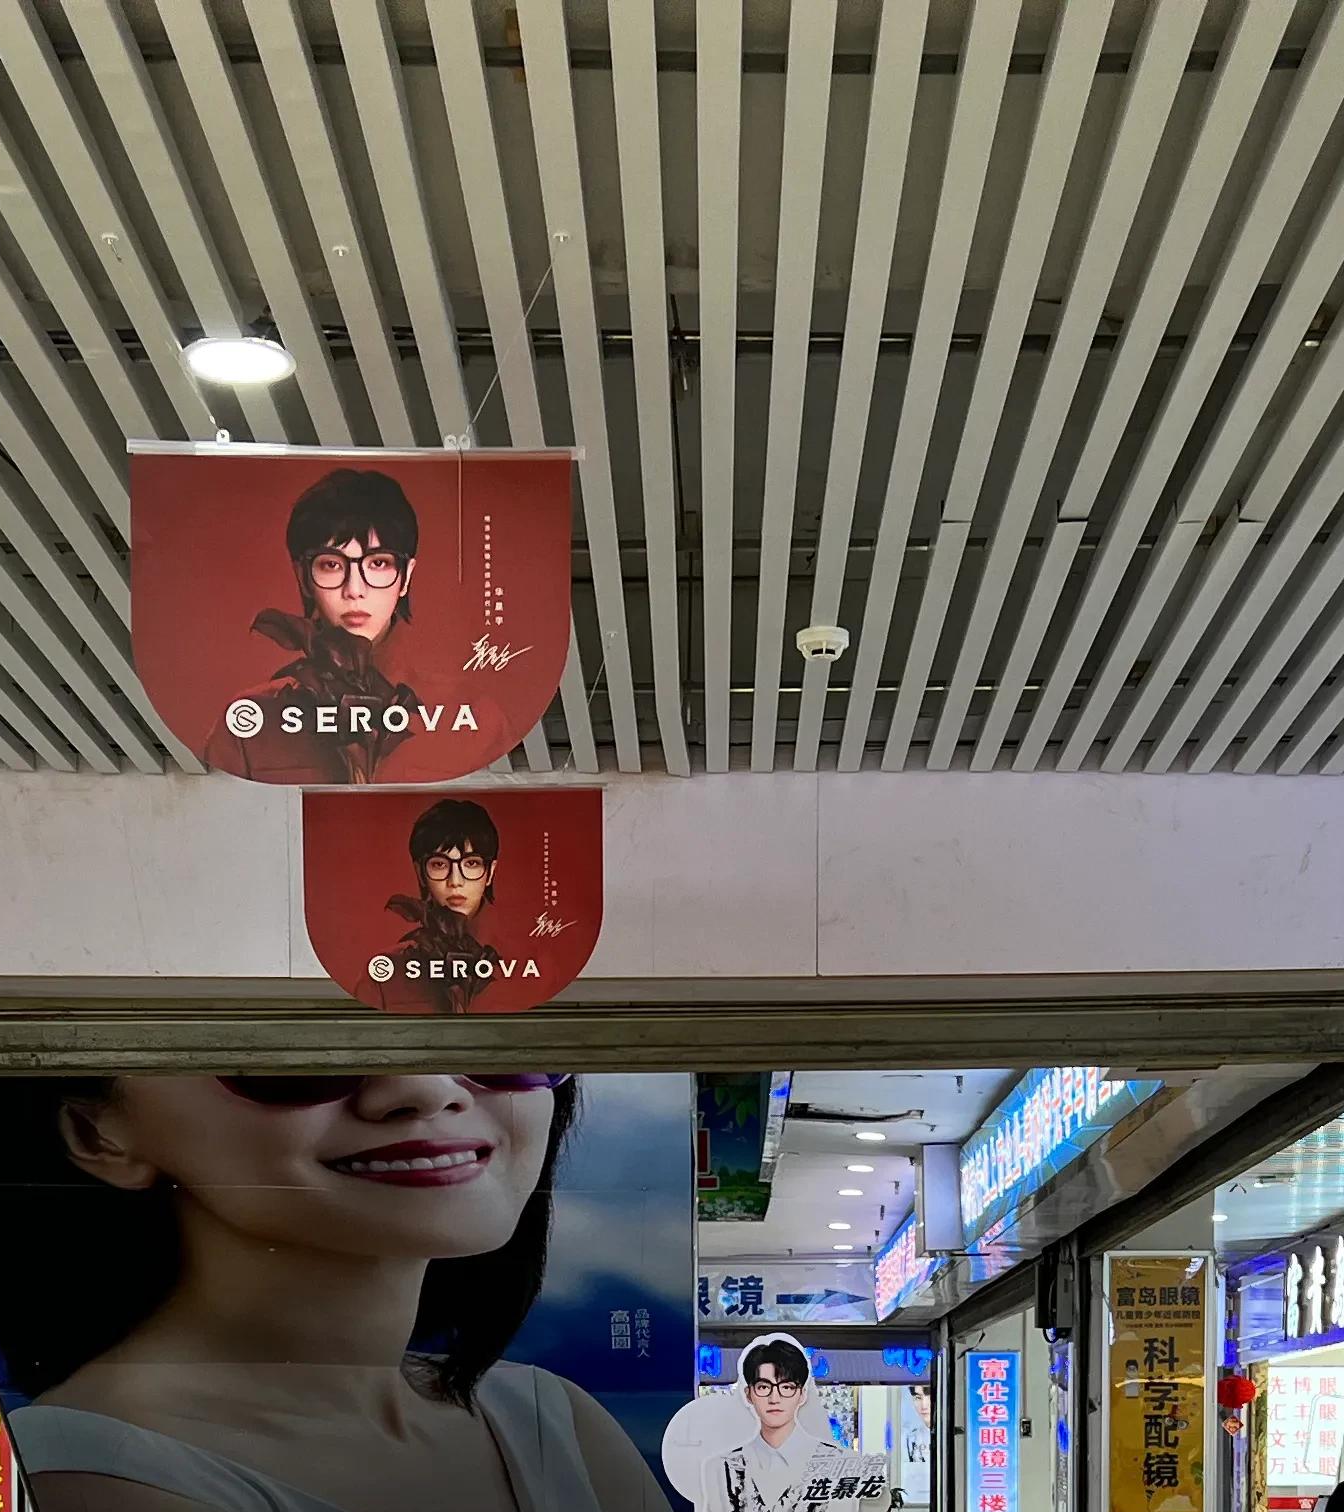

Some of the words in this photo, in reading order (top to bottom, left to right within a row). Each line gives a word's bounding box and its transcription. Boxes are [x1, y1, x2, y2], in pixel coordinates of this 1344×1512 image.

[280, 704, 479, 733] SEROVA
[405, 959, 542, 980] SEROVA
[1116, 1286, 1201, 1307] 富岛眼镜
[1143, 1336, 1180, 1488] 科学配镜
[802, 1475, 886, 1502] 选暴龙
